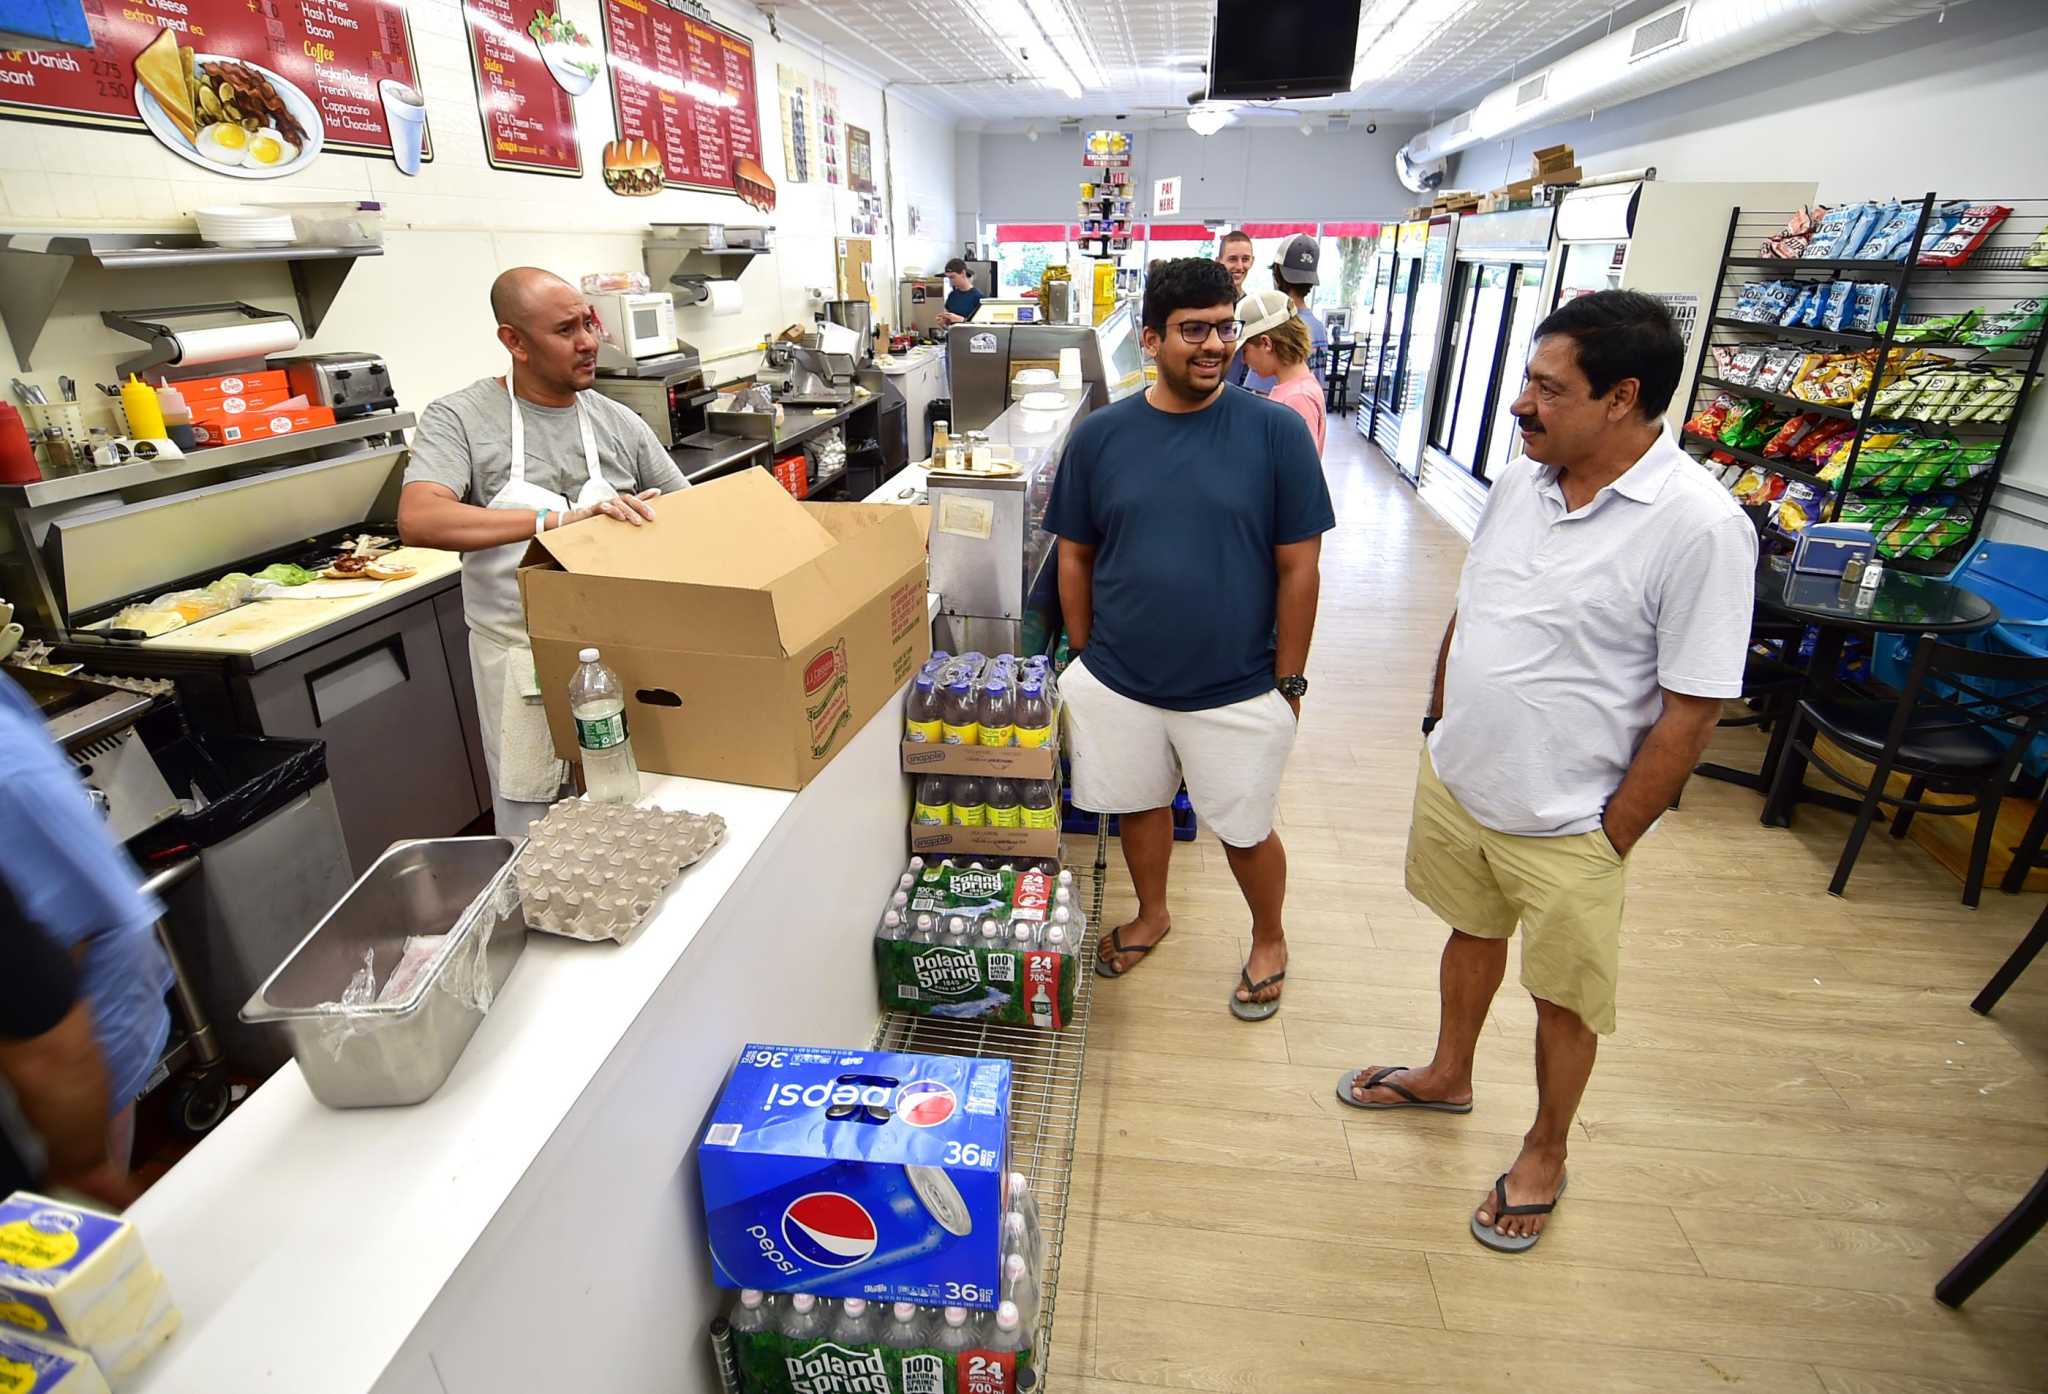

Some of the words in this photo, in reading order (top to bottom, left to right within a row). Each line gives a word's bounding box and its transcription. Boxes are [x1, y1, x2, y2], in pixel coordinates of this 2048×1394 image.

[122, 8, 154, 24] extra
[156, 15, 188, 33] meat
[301, 2, 327, 22] Hash
[326, 9, 359, 30] Browns
[304, 19, 335, 40] Bacon
[27, 50, 81, 72] Danish
[303, 39, 335, 64] Coffee
[482, 56, 504, 73] Sides
[317, 80, 349, 98] French
[321, 96, 371, 117] Cappuccino
[324, 113, 342, 128] Hot
[341, 116, 383, 133] Chocolate
[1161, 181, 1174, 196] PAY
[1159, 197, 1175, 212] HERE
[1814, 222, 1844, 235] JOE
[1766, 286, 1793, 304] JOE
[1752, 307, 1780, 323] CHIPS
[949, 881, 1003, 895] Spring
[950, 872, 1002, 886] Poland
[1023, 874, 1045, 885] 24
[912, 949, 978, 971] Poland
[1029, 955, 1053, 971] 24
[916, 965, 982, 989] Spring
[753, 1051, 790, 1068] 36
[762, 1079, 892, 1112] pepsi
[943, 1141, 981, 1167] 36
[745, 1224, 802, 1277] pepsi
[944, 1282, 979, 1302] 36
[785, 1348, 887, 1381] Poland
[968, 1356, 1004, 1380] 24
[791, 1373, 891, 1394] Spring
[905, 1373, 939, 1382] NATURAL
[906, 1379, 935, 1388] SPRING
[906, 1385, 934, 1393] WATER
